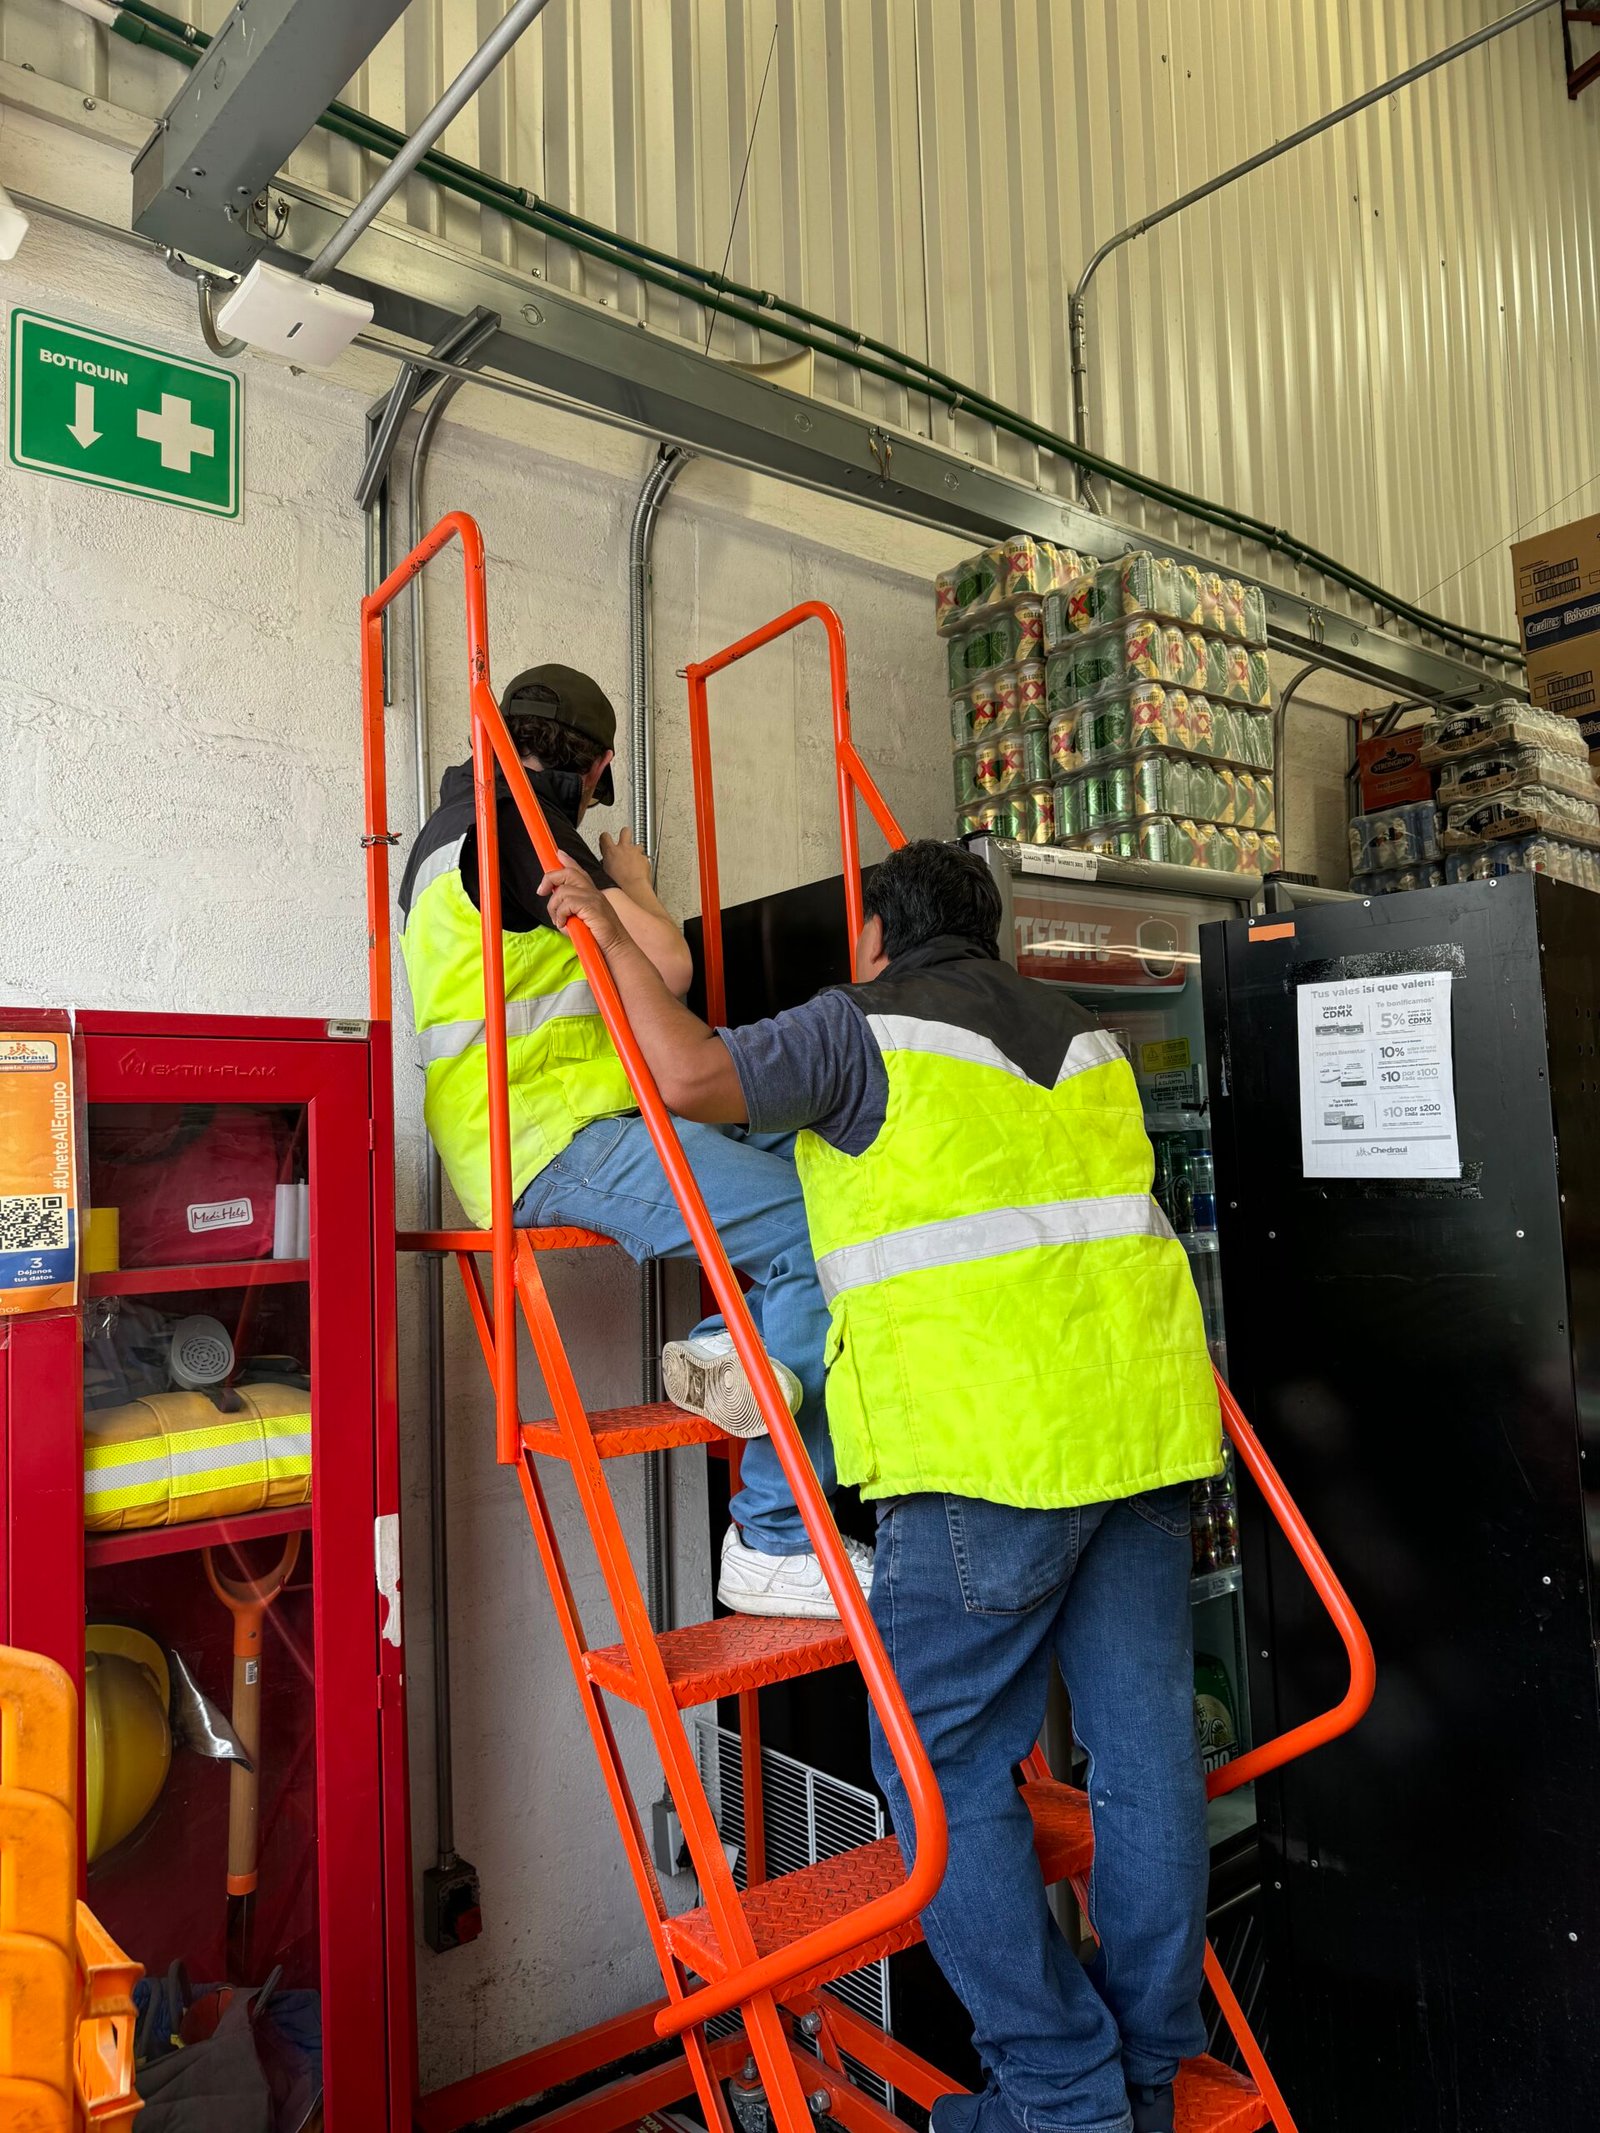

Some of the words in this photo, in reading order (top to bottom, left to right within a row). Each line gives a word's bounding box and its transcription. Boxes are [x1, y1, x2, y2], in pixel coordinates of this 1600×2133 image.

[40, 348, 128, 385] BOTIQUIN
[1014, 916, 1112, 962] TECATE
[1311, 990, 1330, 999] Tus
[1332, 986, 1360, 997] vales
[1377, 983, 1398, 993] que
[1401, 978, 1435, 990] valen!
[1323, 1009, 1353, 1019] CDMX
[1381, 1013, 1406, 1029] 5%
[1408, 1017, 1432, 1025] CDMX
[1379, 1046, 1405, 1058] 10%
[1381, 1071, 1401, 1082] $10
[1402, 1070, 1415, 1078] por
[1417, 1068, 1438, 1077] $100
[1383, 1106, 1403, 1118] $10
[1419, 1103, 1441, 1112] $200
[50, 1081, 71, 1190] #ÚneteAlEquipo
[1370, 1145, 1408, 1154] Chedraui
[30, 1257, 43, 1269] 3
[17, 1268, 52, 1277] Déjanos
